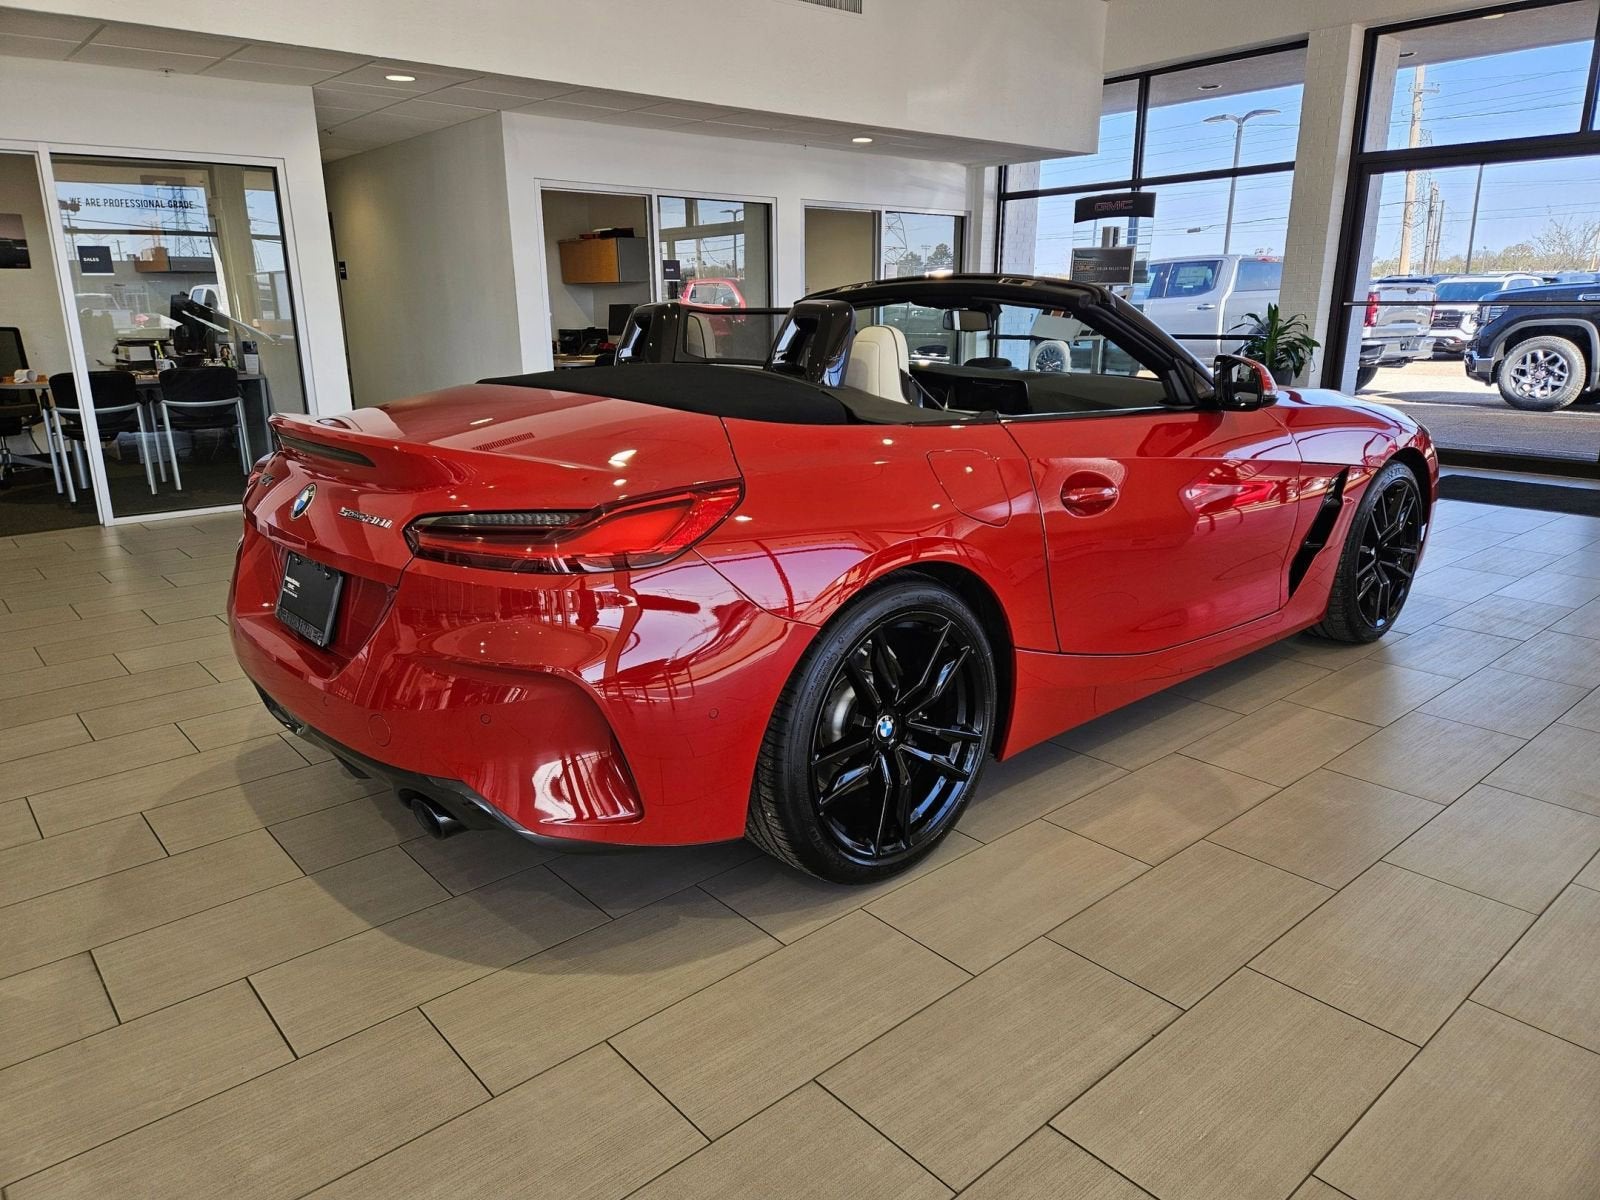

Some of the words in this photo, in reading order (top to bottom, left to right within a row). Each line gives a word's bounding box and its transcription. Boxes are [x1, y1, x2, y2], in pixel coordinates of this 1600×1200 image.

[85, 198, 101, 207] ARE
[103, 199, 165, 208] PROFESSIONAL
[167, 199, 195, 209] GRADE
[1094, 199, 1134, 211] GMC
